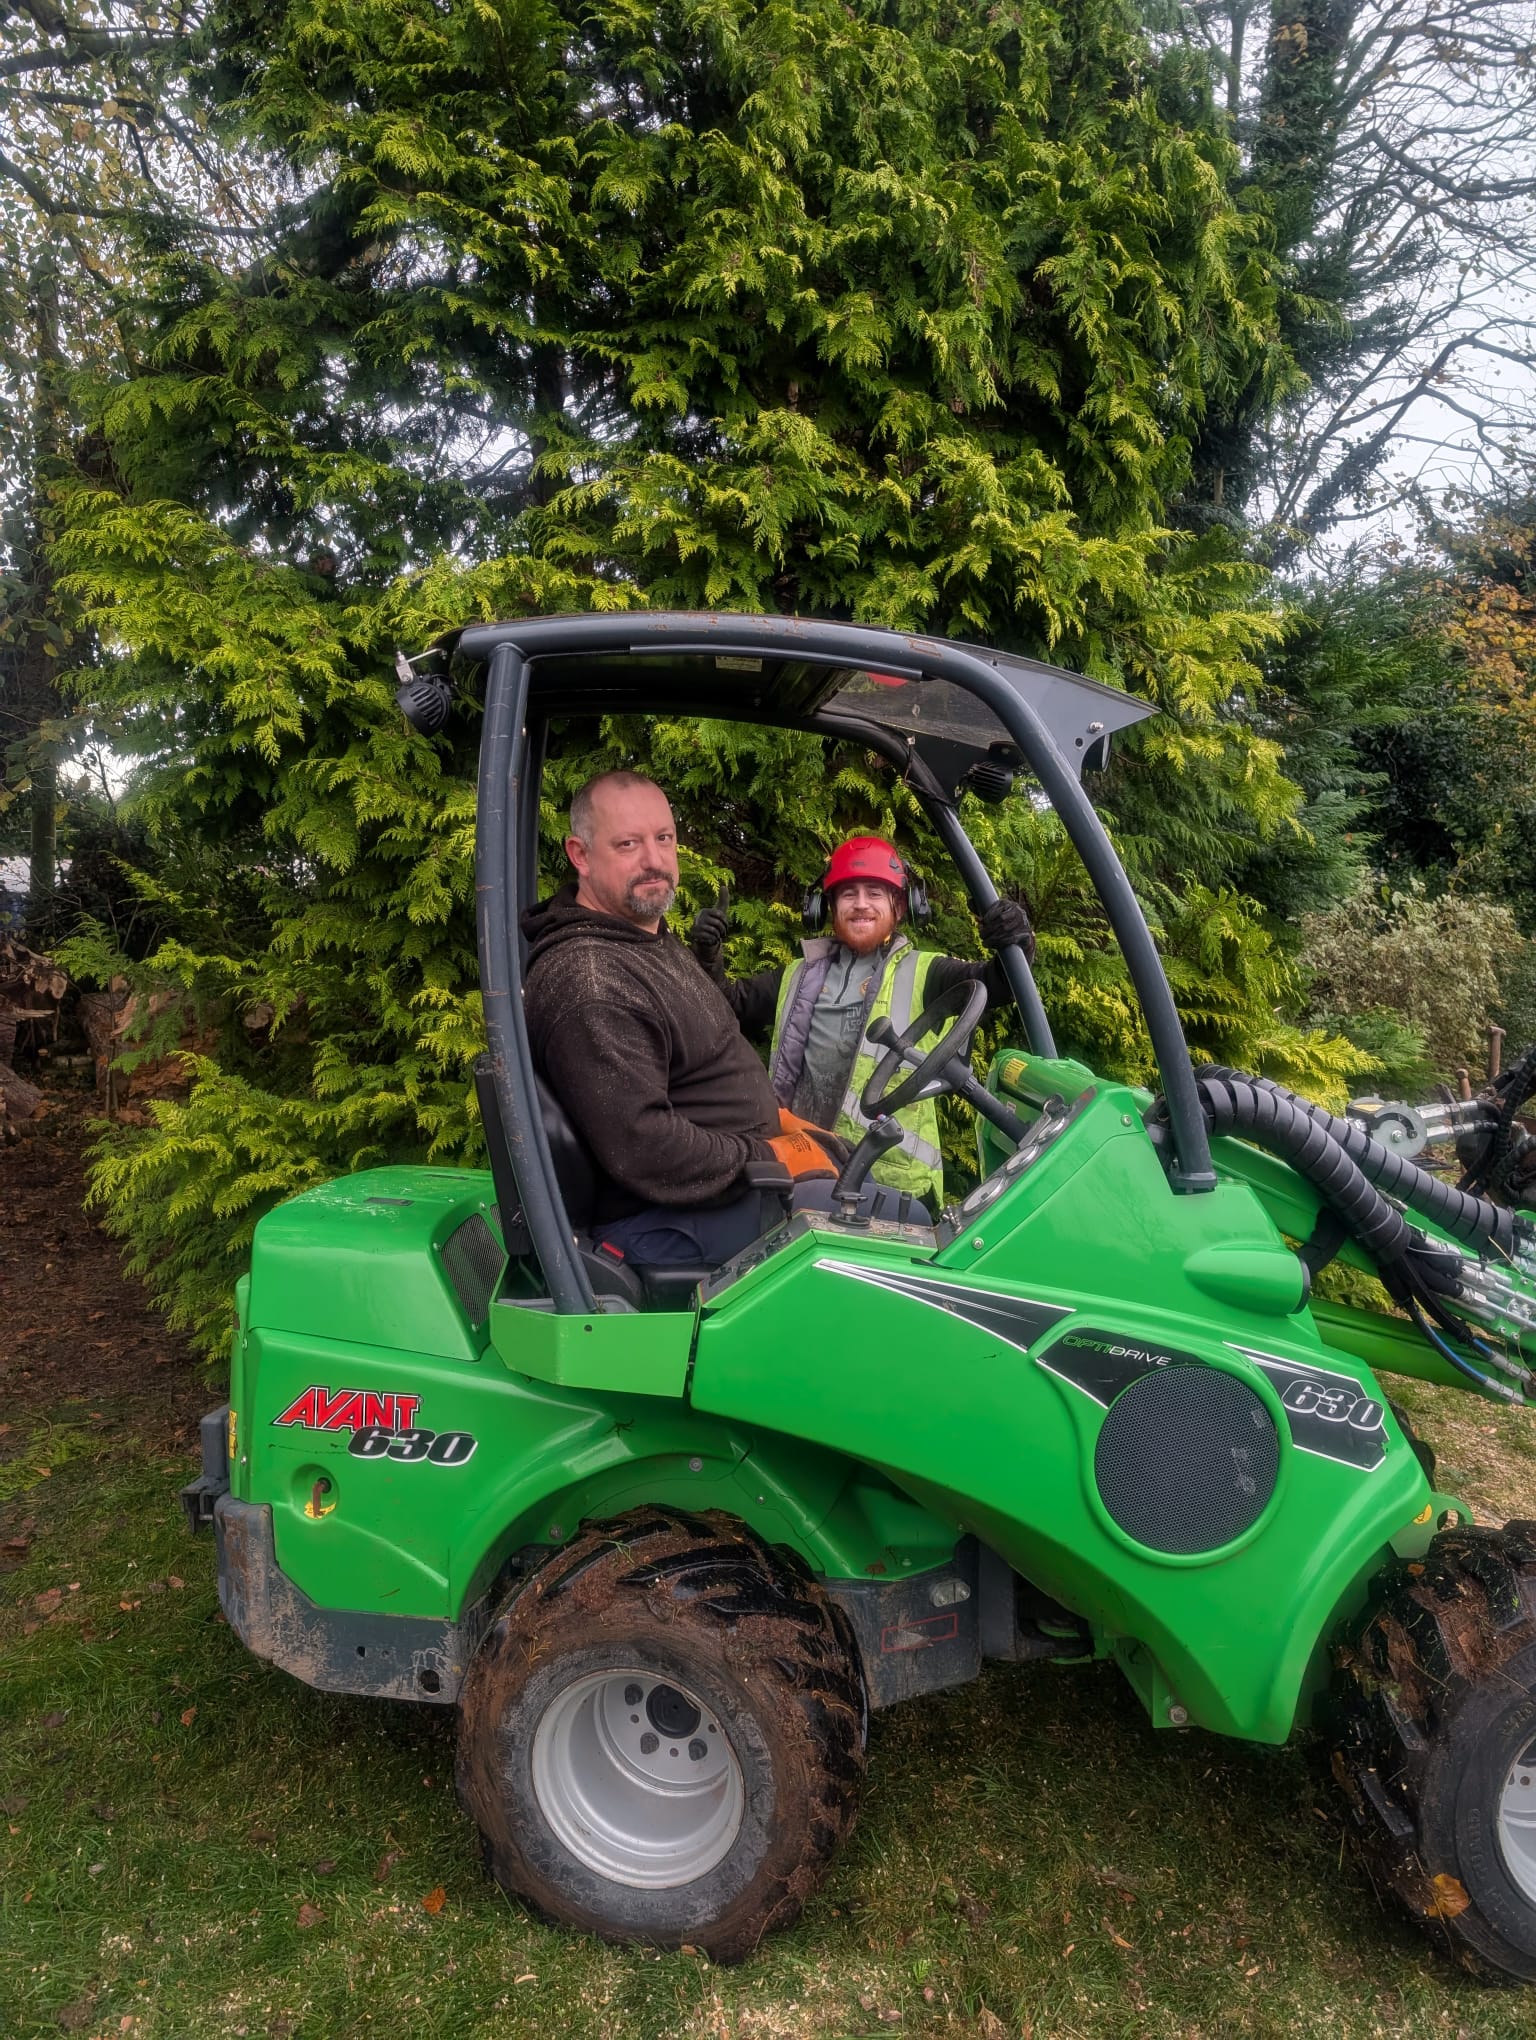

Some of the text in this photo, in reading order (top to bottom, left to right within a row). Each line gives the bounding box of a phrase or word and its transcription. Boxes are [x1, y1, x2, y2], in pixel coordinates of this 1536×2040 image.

[1062, 1335, 1172, 1366] OPTIDRIVE
[270, 1385, 423, 1433] AVANT
[1281, 1379, 1385, 1431] 630
[348, 1425, 478, 1466] 630
